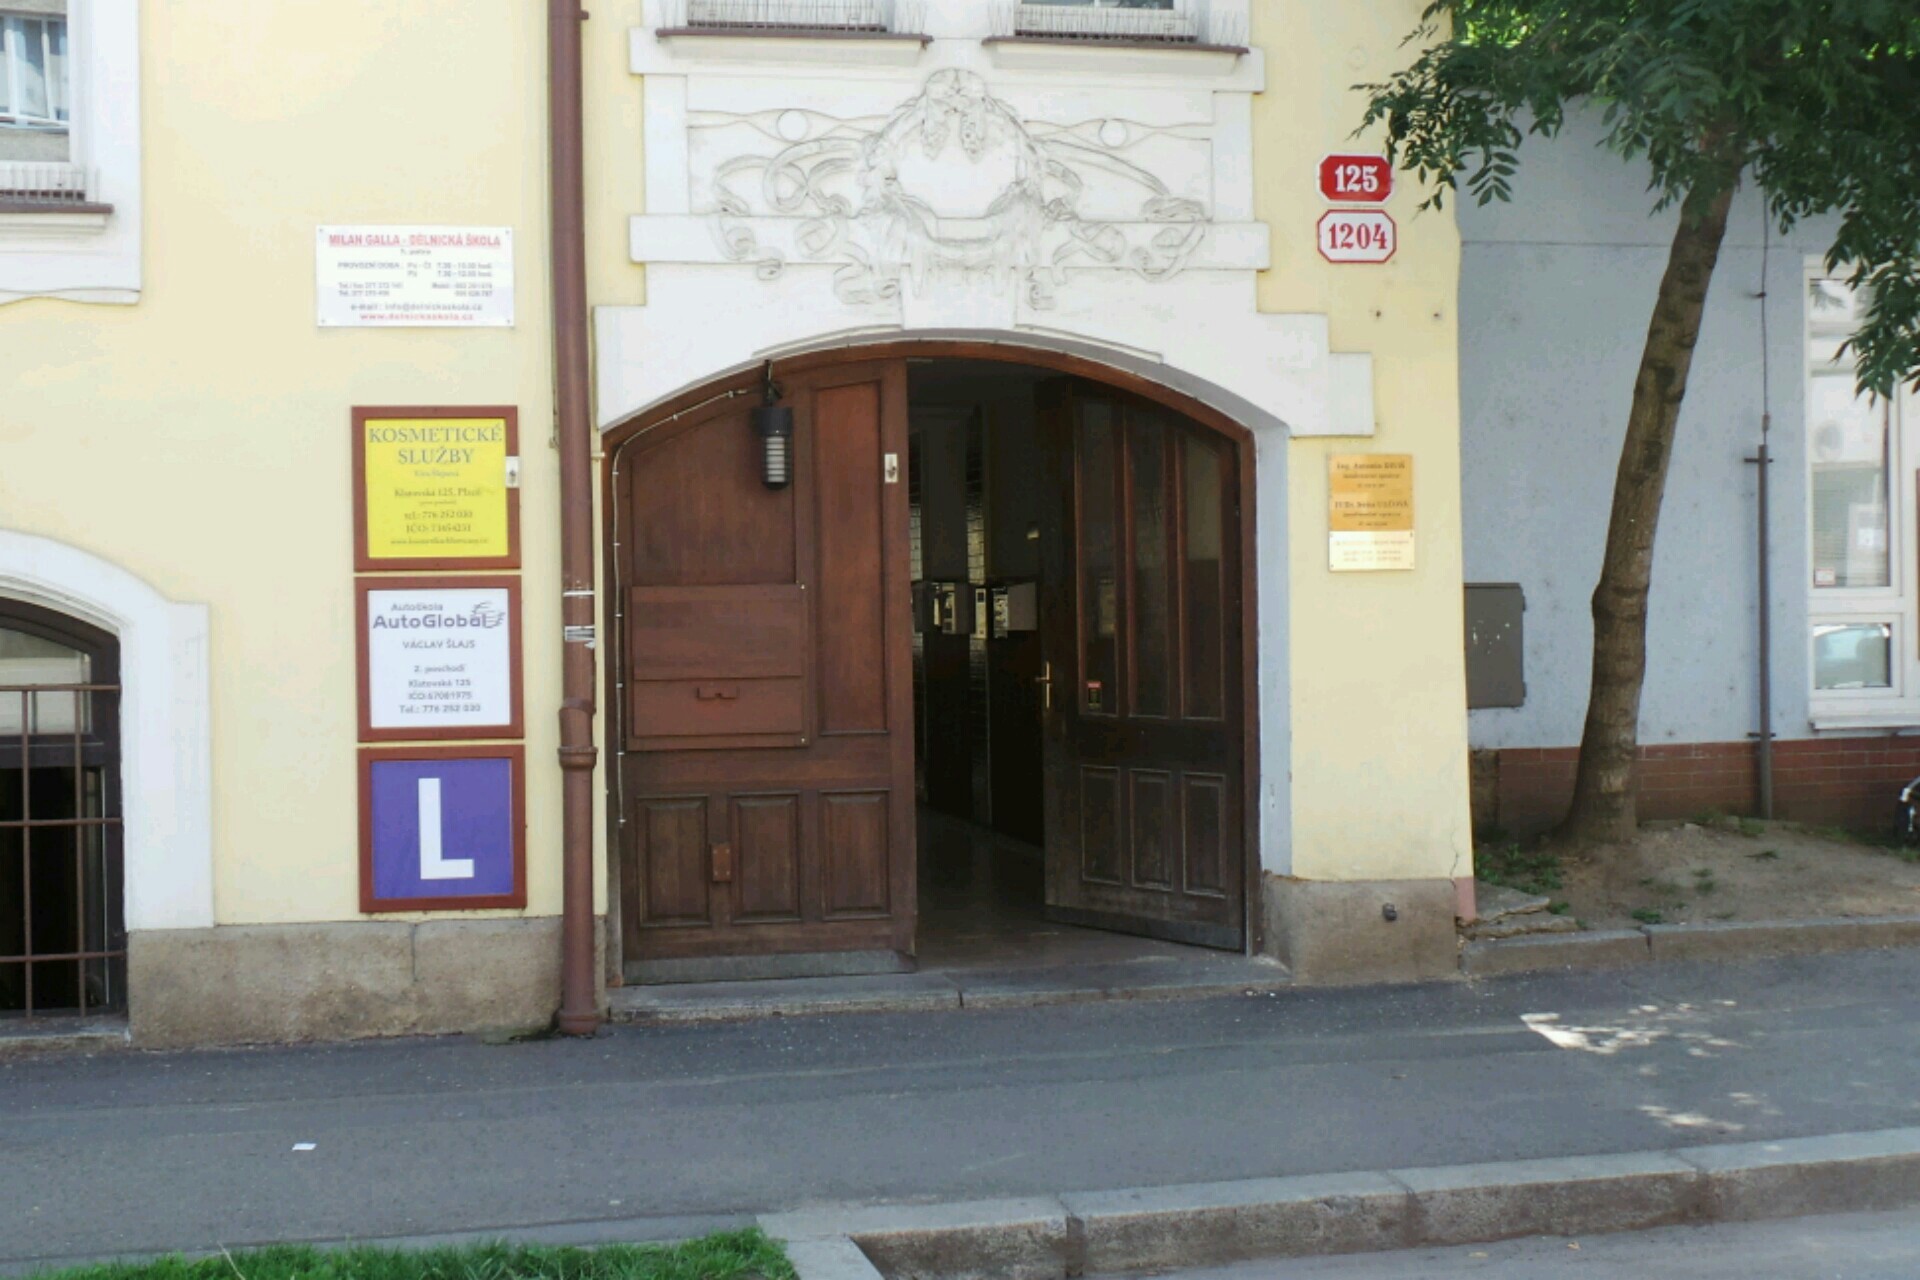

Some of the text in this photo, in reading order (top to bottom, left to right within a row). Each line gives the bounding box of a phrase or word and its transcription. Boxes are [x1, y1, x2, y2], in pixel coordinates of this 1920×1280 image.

[1335, 164, 1379, 192] 125
[329, 234, 362, 246] MILAN
[366, 234, 400, 246] GALLA
[465, 233, 501, 246] ŠKOLA
[1328, 223, 1387, 249] 1204
[369, 424, 502, 443] KOSMETICKÉ
[398, 446, 474, 464] SLUŽBY
[373, 614, 486, 629] AutoGlobal
[402, 637, 443, 649] VÁCLAV
[418, 778, 474, 880] L
